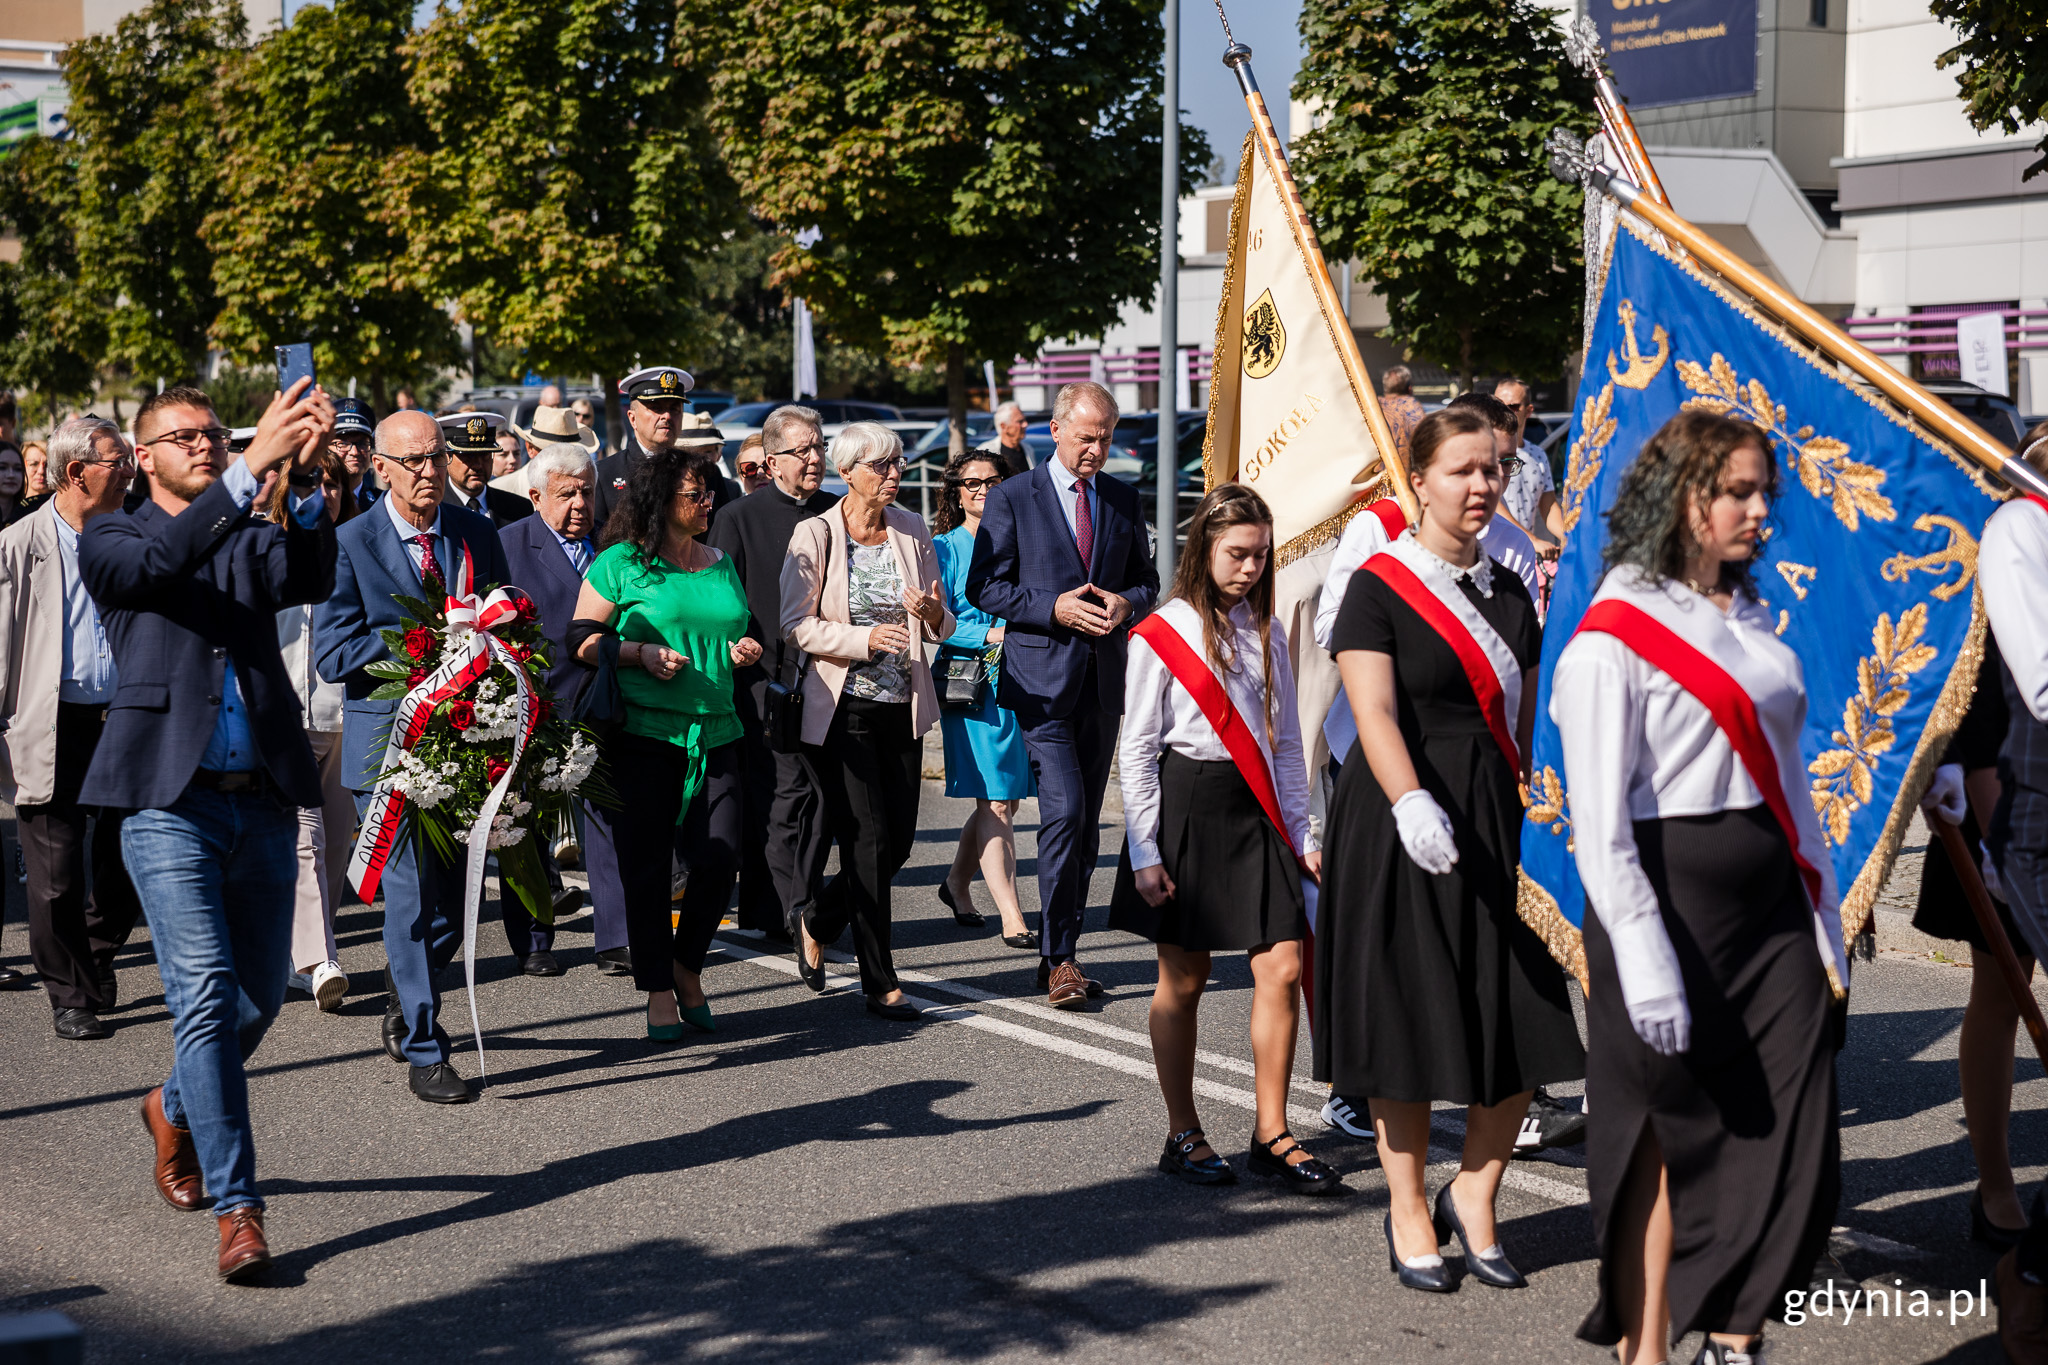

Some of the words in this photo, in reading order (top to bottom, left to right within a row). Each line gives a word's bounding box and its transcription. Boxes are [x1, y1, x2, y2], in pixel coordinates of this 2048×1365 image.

[1611, 19, 1647, 35] Member
[1647, 13, 1660, 29] of
[1611, 39, 1626, 52] the
[1626, 35, 1662, 50] Creative
[1661, 30, 1687, 45] Cities
[1687, 21, 1727, 41] Network
[1245, 392, 1326, 483] SOKOŁA
